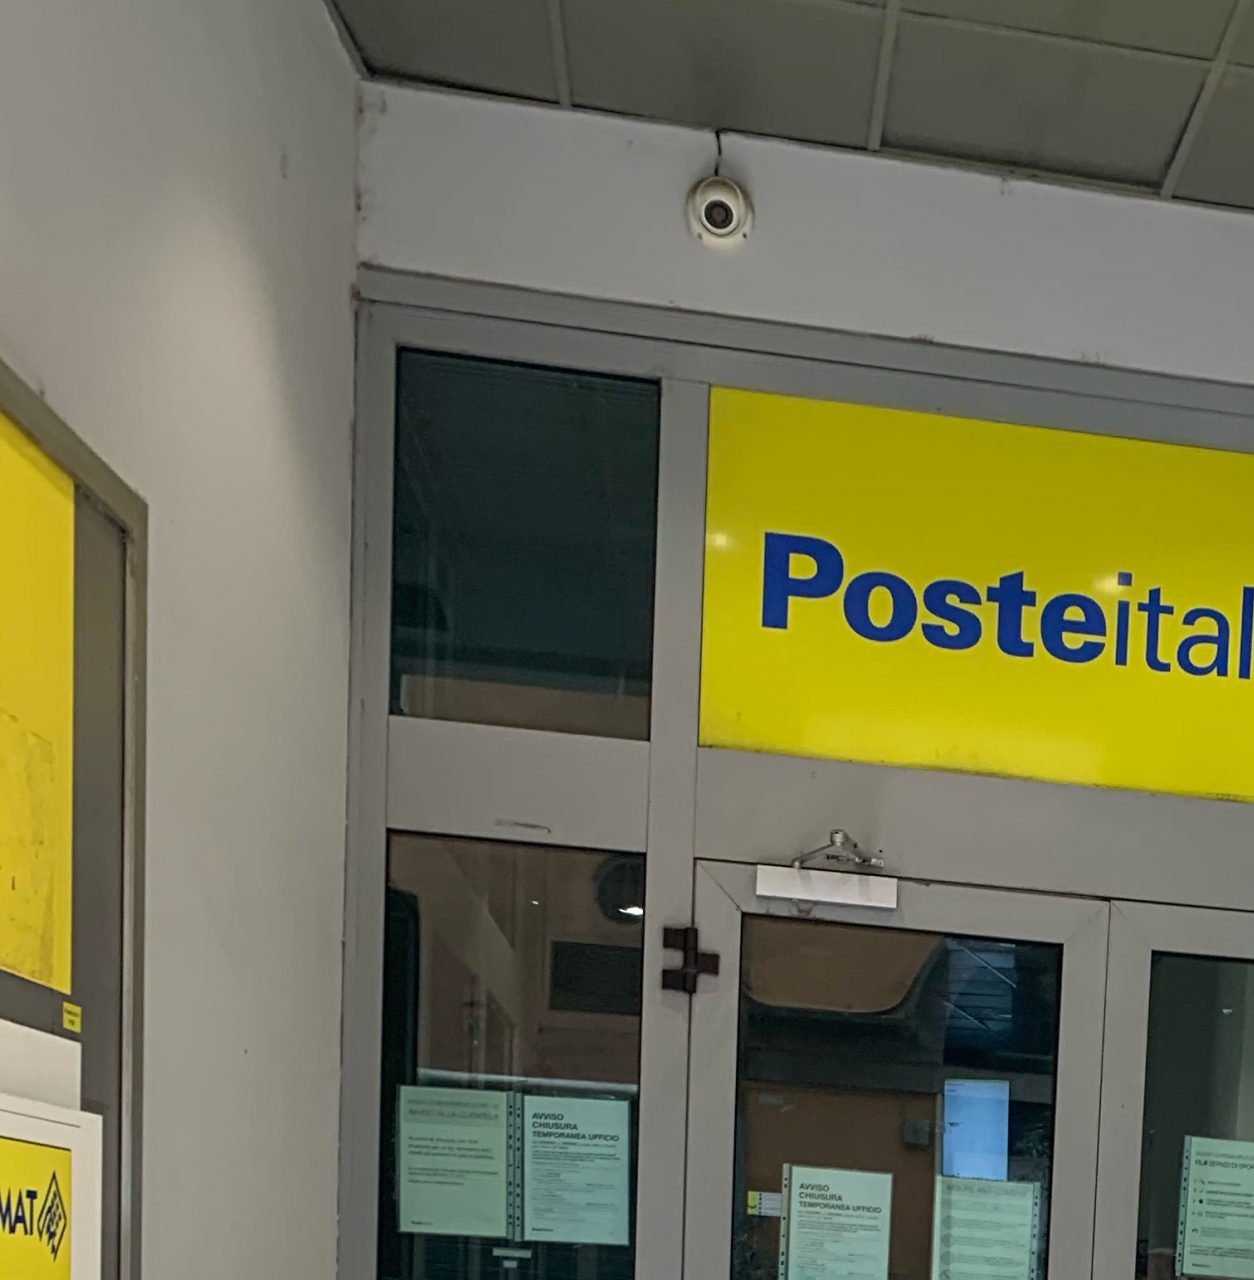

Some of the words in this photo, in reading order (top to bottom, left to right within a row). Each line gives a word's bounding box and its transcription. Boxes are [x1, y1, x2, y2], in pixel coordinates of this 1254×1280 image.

[532, 1112, 564, 1121] AVVISO
[532, 1121, 578, 1131] CHIUSURA
[532, 1130, 586, 1140] TEMPORANEA
[588, 1133, 620, 1142] UFFICIO
[799, 1183, 830, 1192] AVVISO
[799, 1192, 843, 1201] CHIUSURA
[798, 1201, 850, 1211] TEMPORANEA
[852, 1205, 882, 1214] UFFICIO
